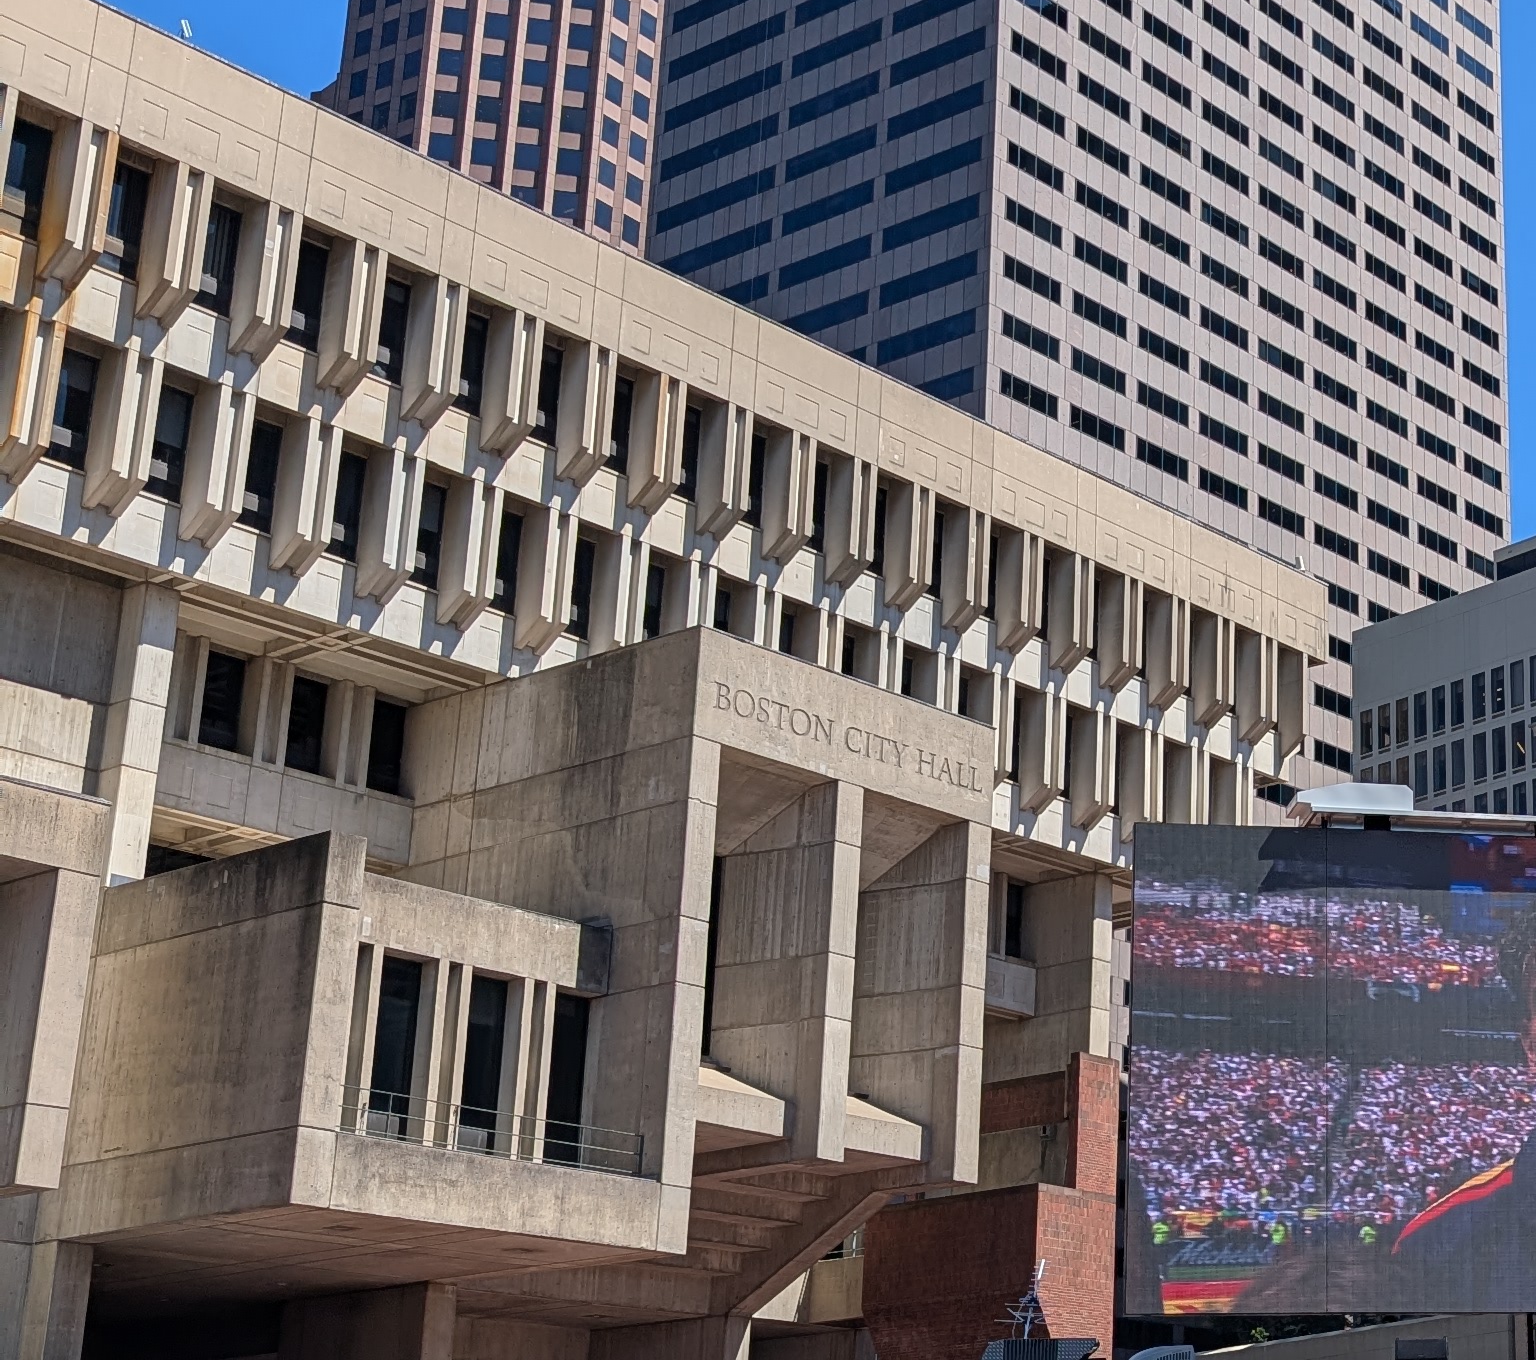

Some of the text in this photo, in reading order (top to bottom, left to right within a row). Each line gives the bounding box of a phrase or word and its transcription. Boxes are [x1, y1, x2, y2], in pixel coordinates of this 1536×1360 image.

[713, 681, 983, 792] BOSTON CITY HALL
